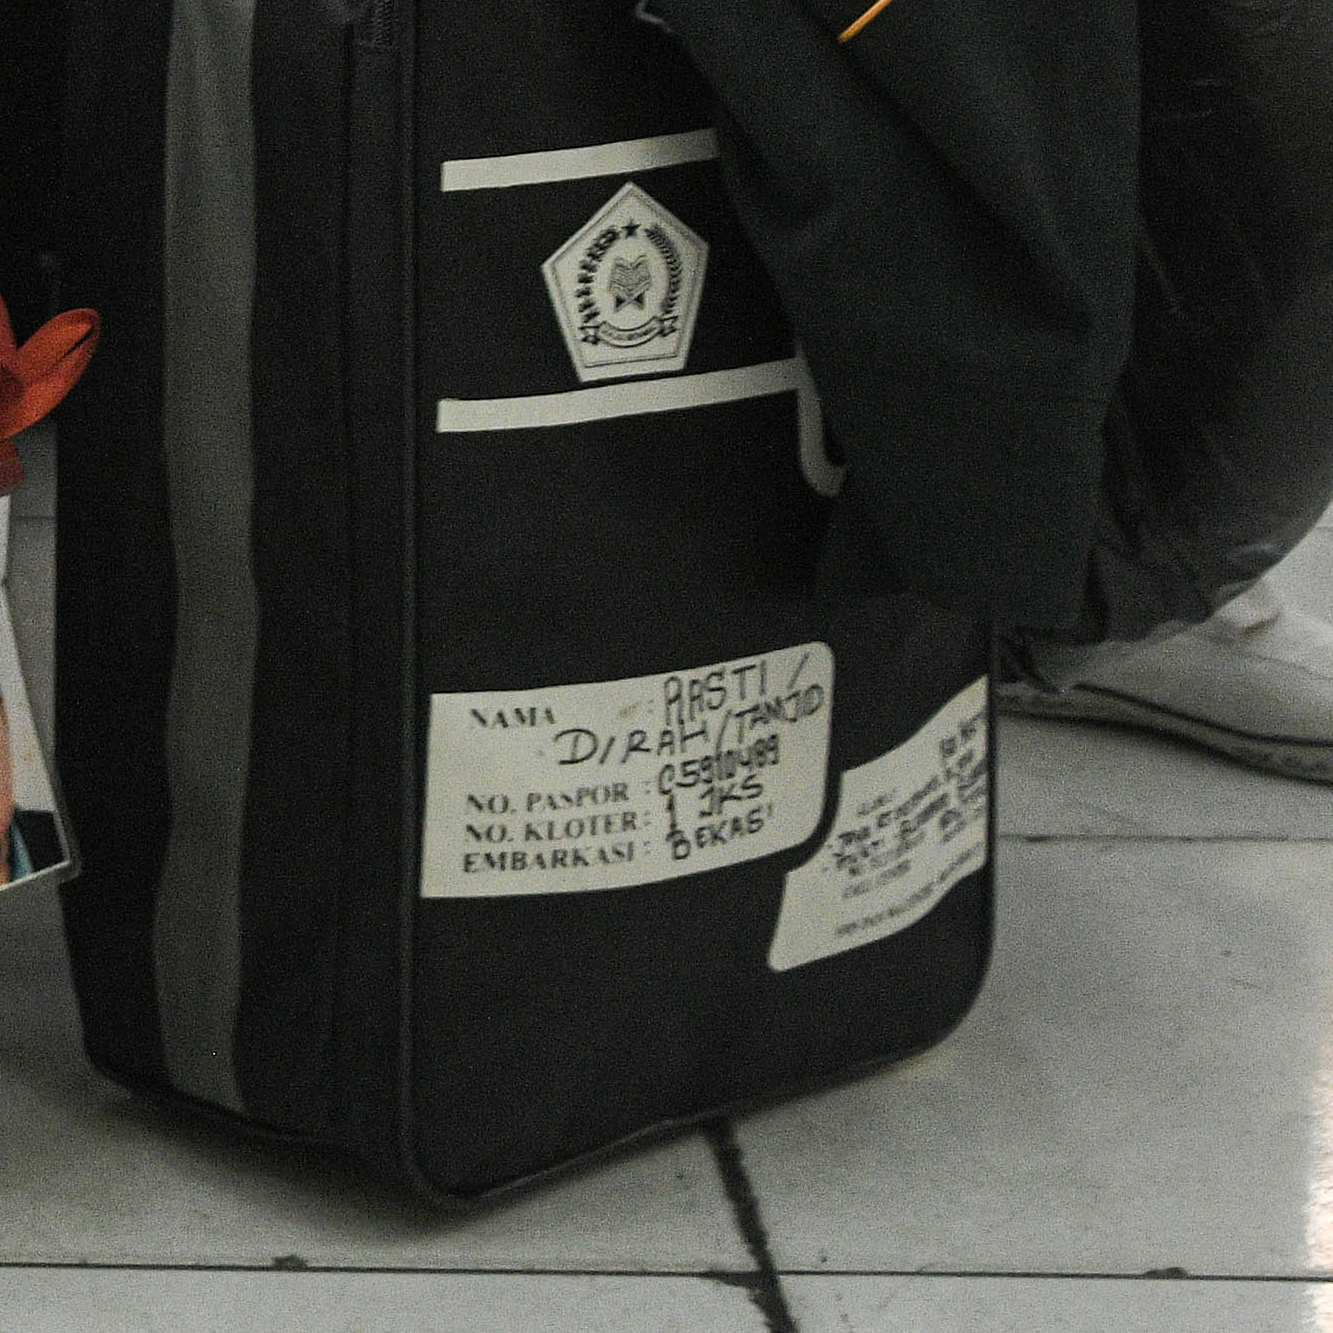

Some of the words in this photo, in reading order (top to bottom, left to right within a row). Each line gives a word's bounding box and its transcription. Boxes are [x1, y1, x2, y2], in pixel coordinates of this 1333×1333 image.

[470, 706, 556, 729] NAMA
[465, 793, 516, 815] NO.
[526, 782, 629, 813] PASPOR
[465, 823, 514, 843] NO.
[524, 812, 637, 843] KLOTER
[463, 841, 635, 874] EMBARKASI
